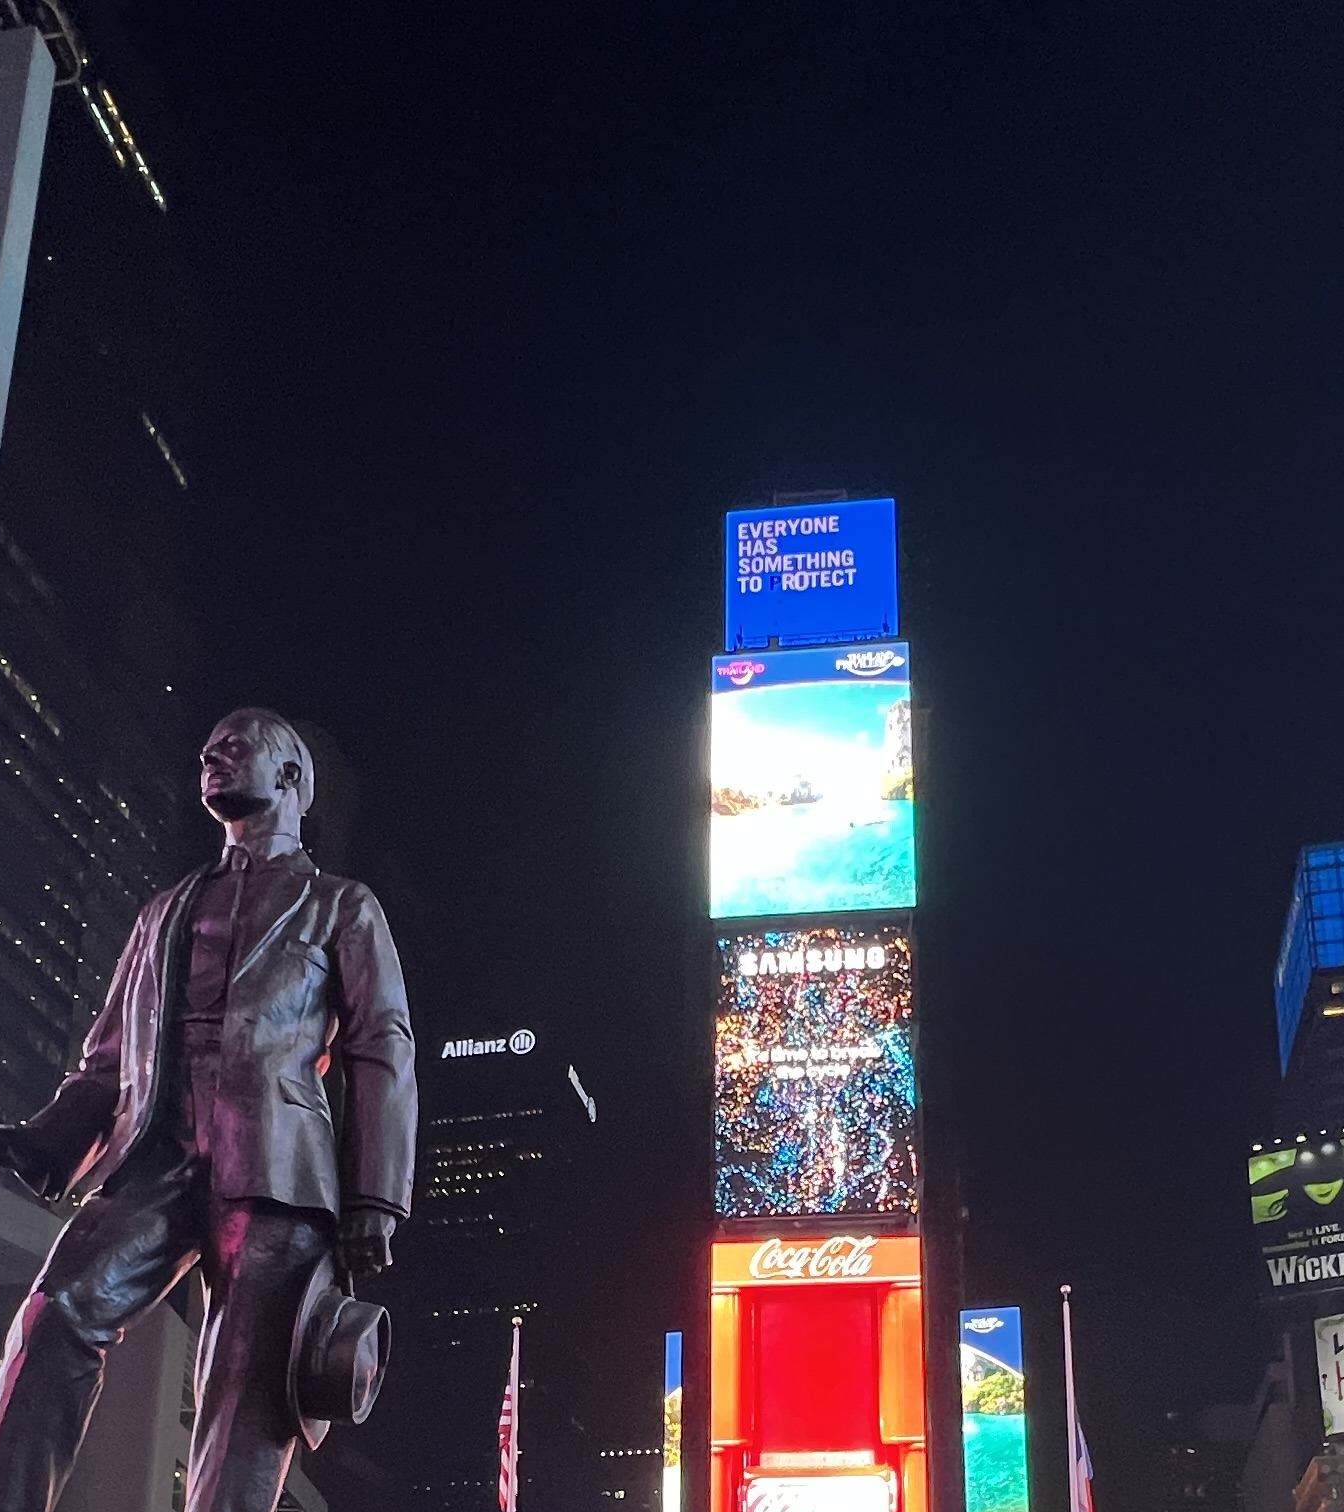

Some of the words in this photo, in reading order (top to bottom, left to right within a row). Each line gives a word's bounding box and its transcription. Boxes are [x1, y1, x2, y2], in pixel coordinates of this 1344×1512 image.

[738, 515, 840, 540] EVERYONE
[738, 538, 778, 558] HAS
[738, 550, 855, 575] SOMETHING
[737, 576, 763, 594] TO
[739, 946, 885, 977] SAMSUNG
[441, 1038, 506, 1059] Allianz
[748, 1236, 879, 1278] Coca-Cola
